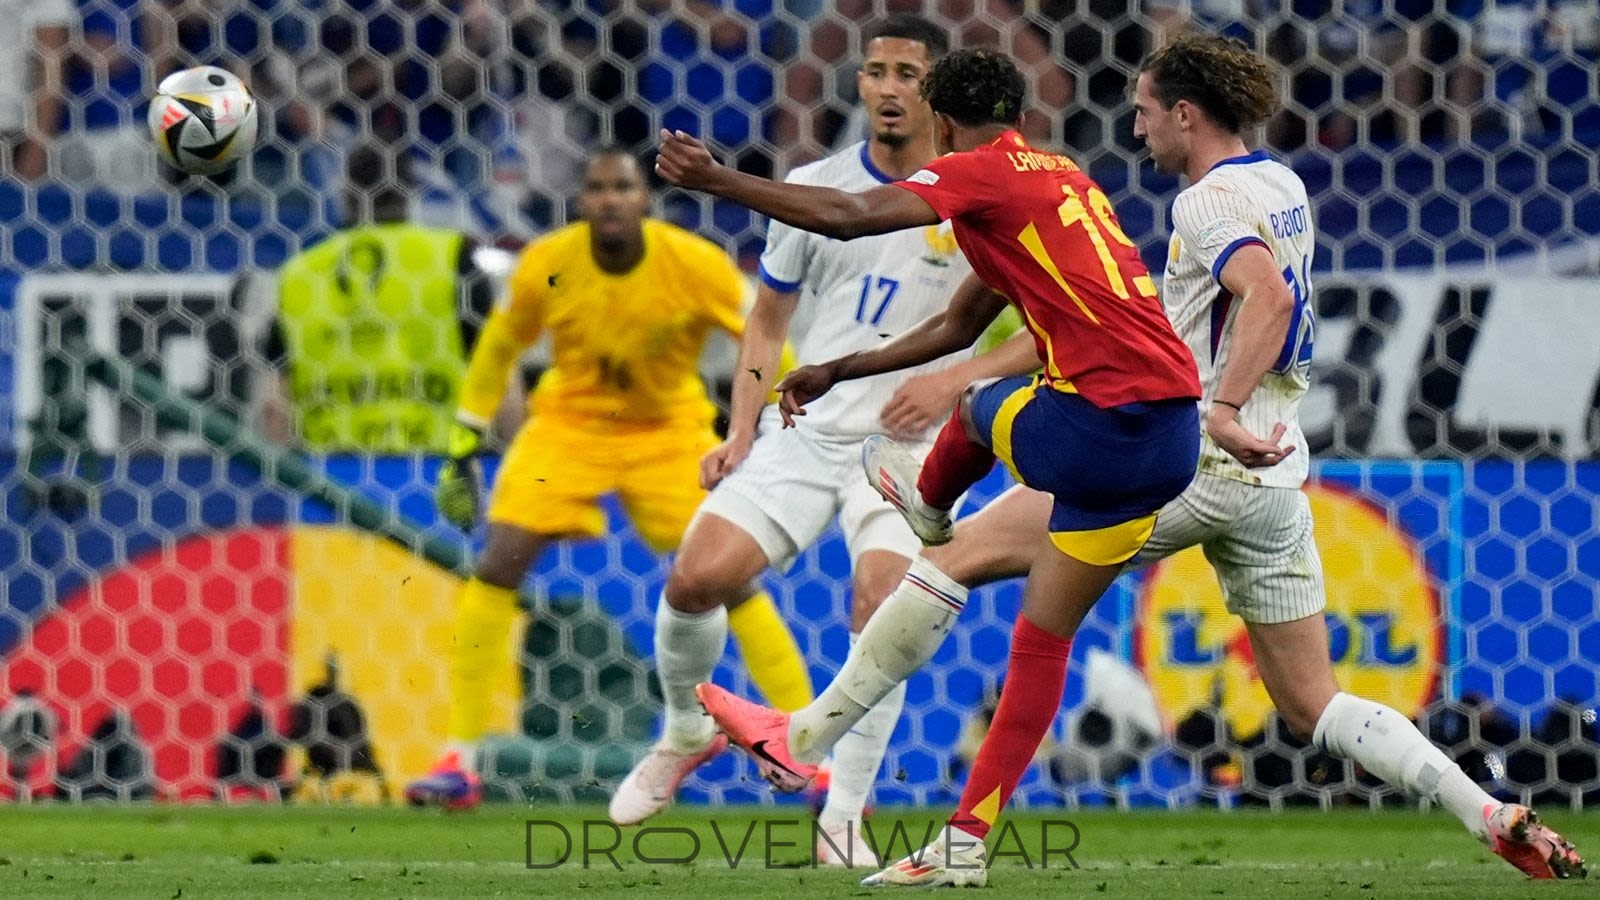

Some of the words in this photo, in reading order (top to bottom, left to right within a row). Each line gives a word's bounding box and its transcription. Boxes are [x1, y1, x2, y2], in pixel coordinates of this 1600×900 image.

[1057, 184, 1158, 300] 19
[855, 273, 900, 327] 17
[1162, 611, 1418, 666] LDL
